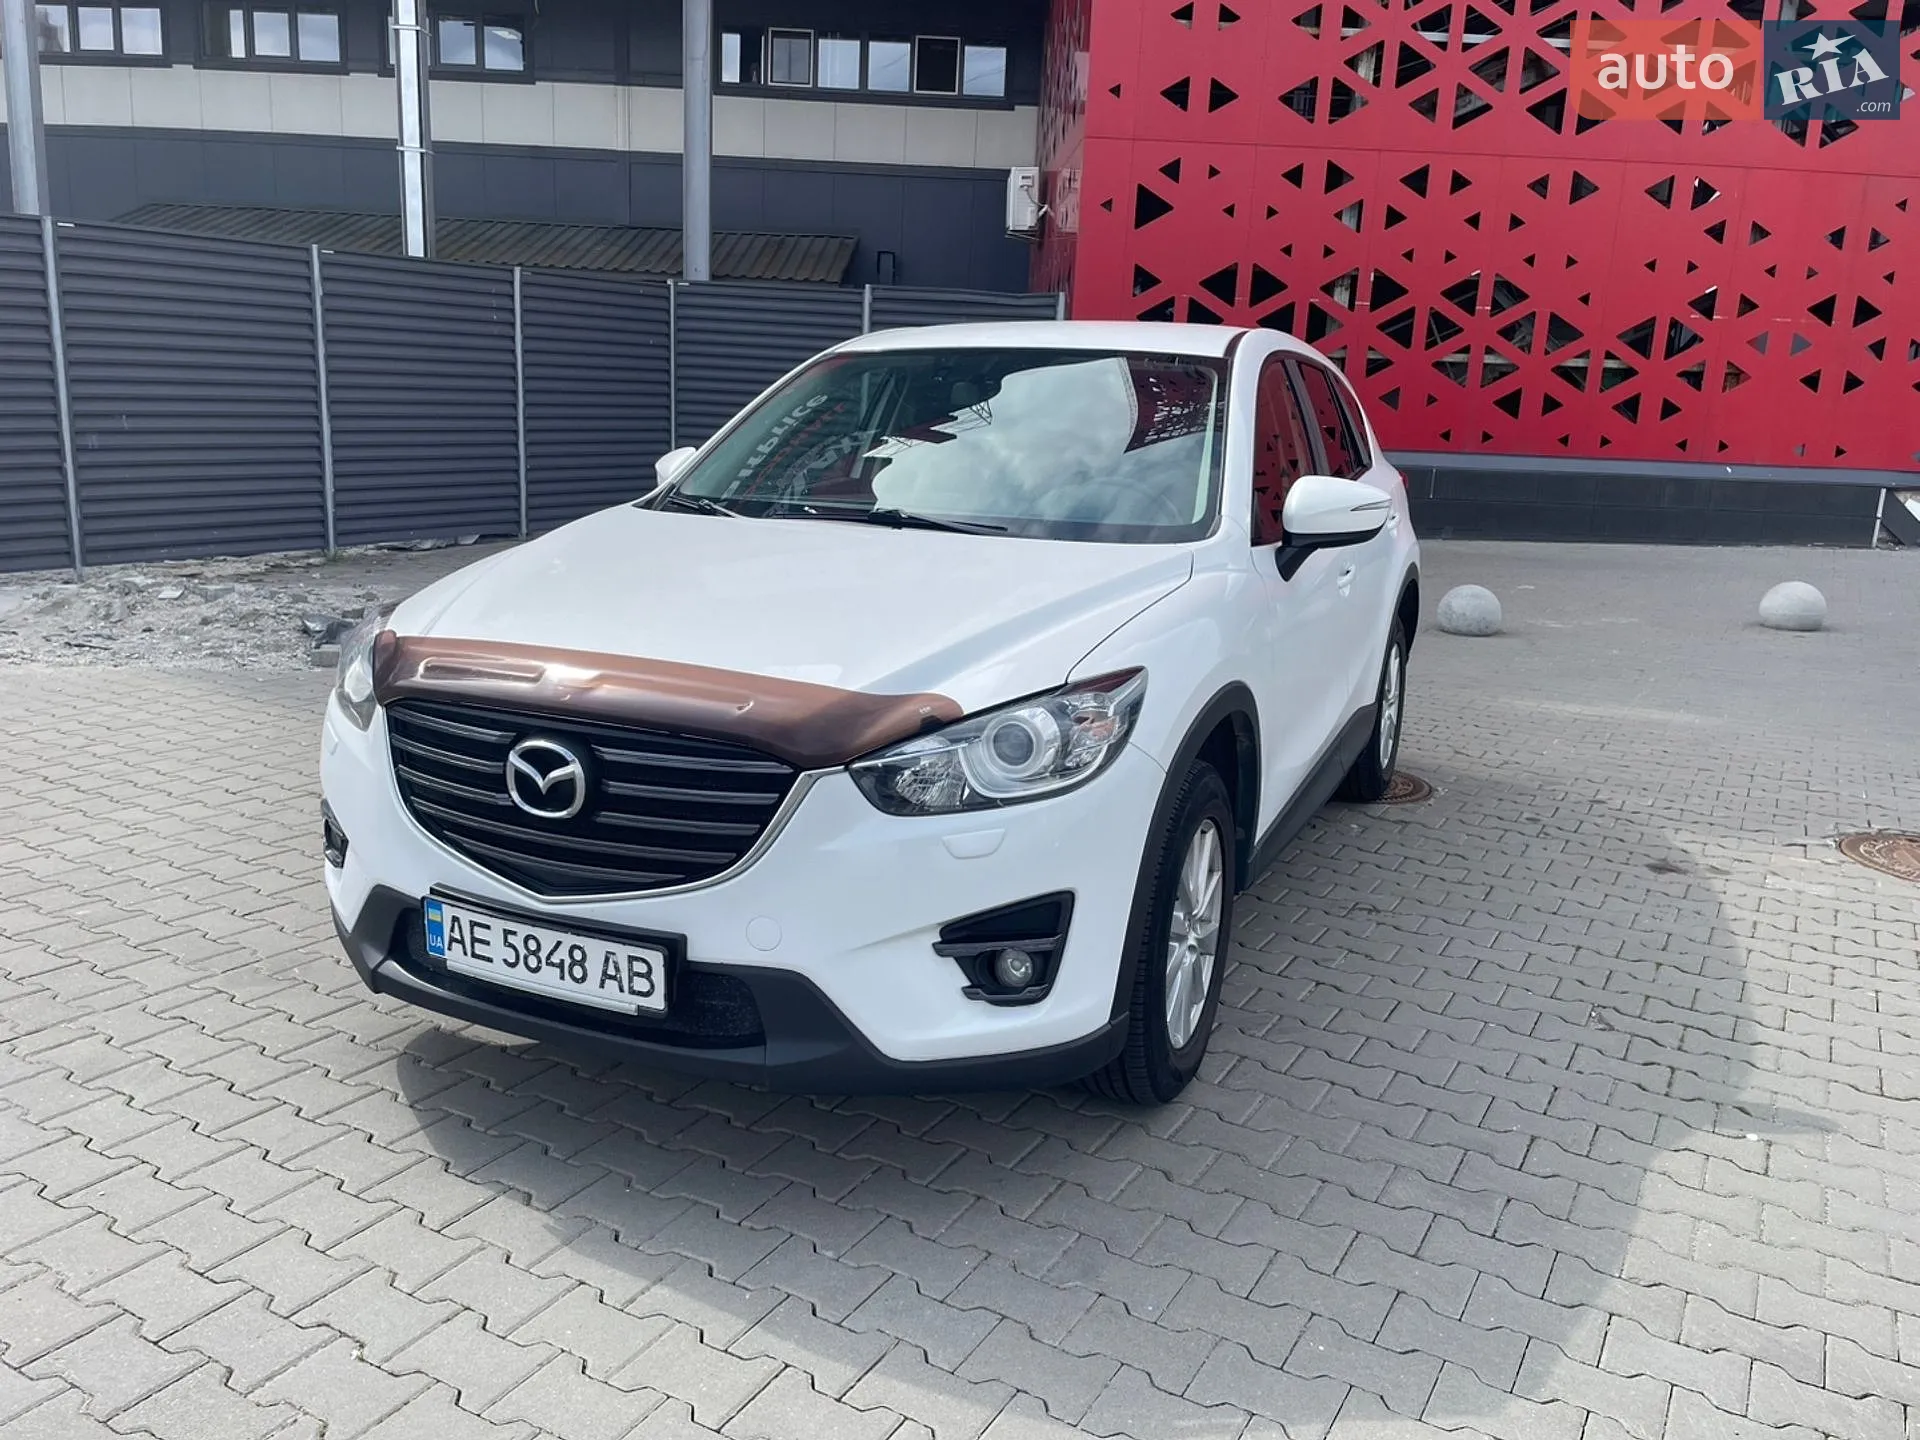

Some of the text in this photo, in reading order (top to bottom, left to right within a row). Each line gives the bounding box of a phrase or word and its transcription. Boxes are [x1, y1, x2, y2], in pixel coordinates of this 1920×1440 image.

[429, 933, 443, 949] UA
[447, 914, 656, 998] AE 5848 AB
